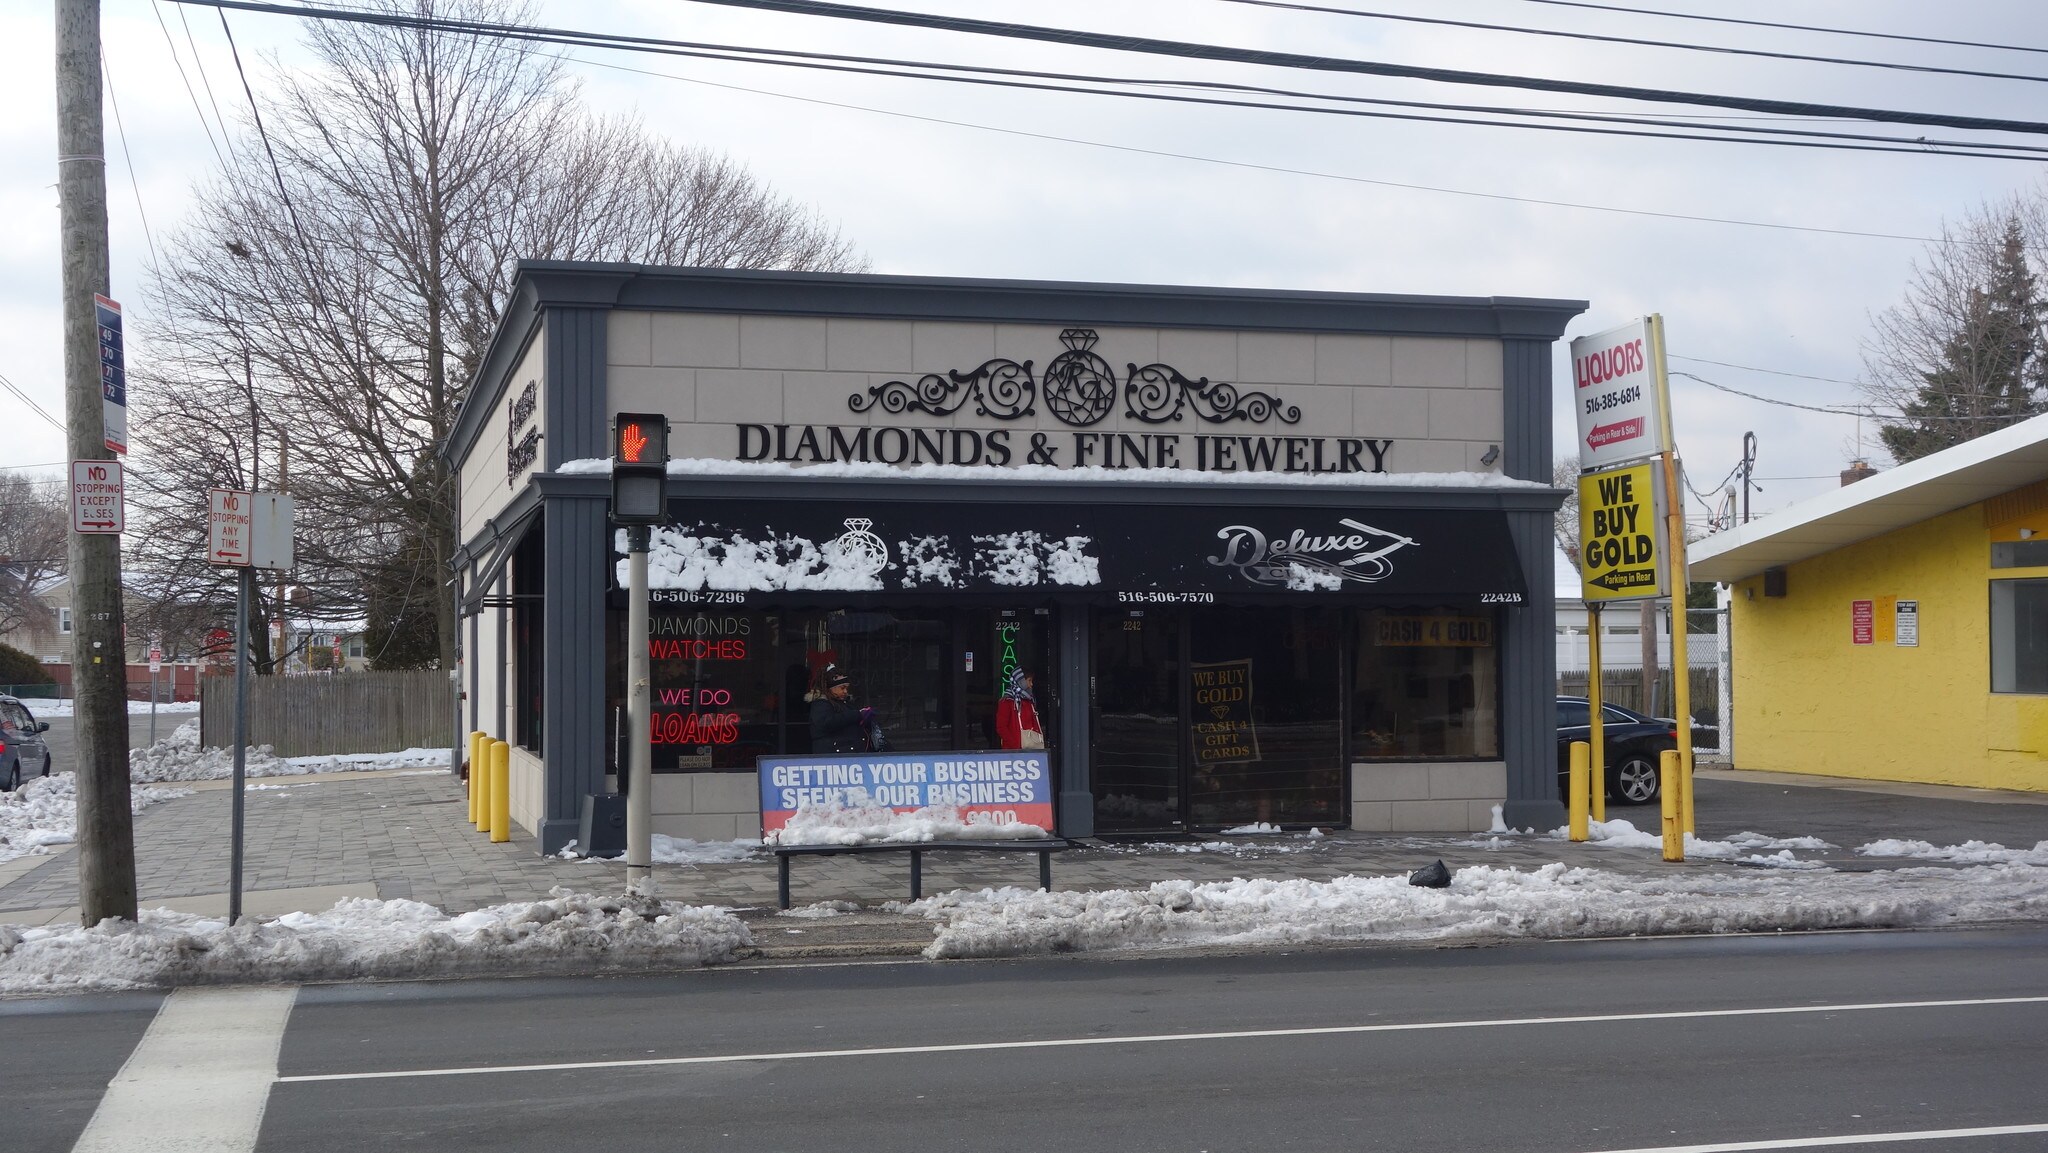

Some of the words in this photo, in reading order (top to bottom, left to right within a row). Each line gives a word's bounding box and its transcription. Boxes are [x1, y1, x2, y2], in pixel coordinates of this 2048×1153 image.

[102, 328, 112, 341] 49
[104, 346, 114, 360] 70
[1577, 339, 1643, 388] LIQUORS
[105, 365, 113, 378] 71
[107, 384, 115, 397] 72
[1586, 385, 1641, 414] 516-385-6814
[1590, 433, 1605, 443] Parking
[1605, 431, 1610, 439] in
[1611, 429, 1621, 438] Rear
[1621, 428, 1626, 436] &
[1626, 425, 1636, 434] Side
[735, 423, 1011, 466] DIAMONDS
[1026, 432, 1059, 467] &
[1072, 433, 1180, 469] FINE
[88, 467, 107, 481] NO
[76, 484, 120, 493] STOPPING
[1598, 474, 1633, 506] WE
[80, 496, 116, 506] EXCEPT
[223, 496, 239, 511] NO
[213, 512, 249, 524] STOPPING
[1593, 504, 1640, 538] BUY
[222, 526, 238, 536] ANY
[221, 538, 239, 549] TIME
[1207, 525, 1370, 566] Deluxe
[1586, 535, 1653, 569] GOLD
[1605, 574, 1627, 585] Parking
[1628, 573, 1635, 582] in
[1636, 572, 1651, 582] Rear
[1118, 591, 1214, 603] 516-506-7570
[1480, 592, 1522, 603] 2242B
[648, 616, 750, 636] DIAMONDS
[1123, 620, 1141, 631] 2242
[1430, 621, 1441, 641] 4
[1448, 621, 1487, 642] GOLD
[648, 640, 746, 660] WATCHES
[1193, 671, 1215, 687] WE
[1218, 669, 1245, 685] BUY
[659, 689, 691, 705] WE
[700, 689, 731, 705] DO
[1196, 686, 1243, 704] GOLD
[651, 712, 742, 744] LOANS
[1240, 720, 1248, 730] 4
[1205, 733, 1239, 746] GIFT
[772, 764, 864, 787] GETTING
[868, 762, 927, 784] YOUR
[934, 760, 1041, 783] BUSINESS
[875, 784, 920, 807] OUR
[927, 781, 1035, 806] BUSINESS
